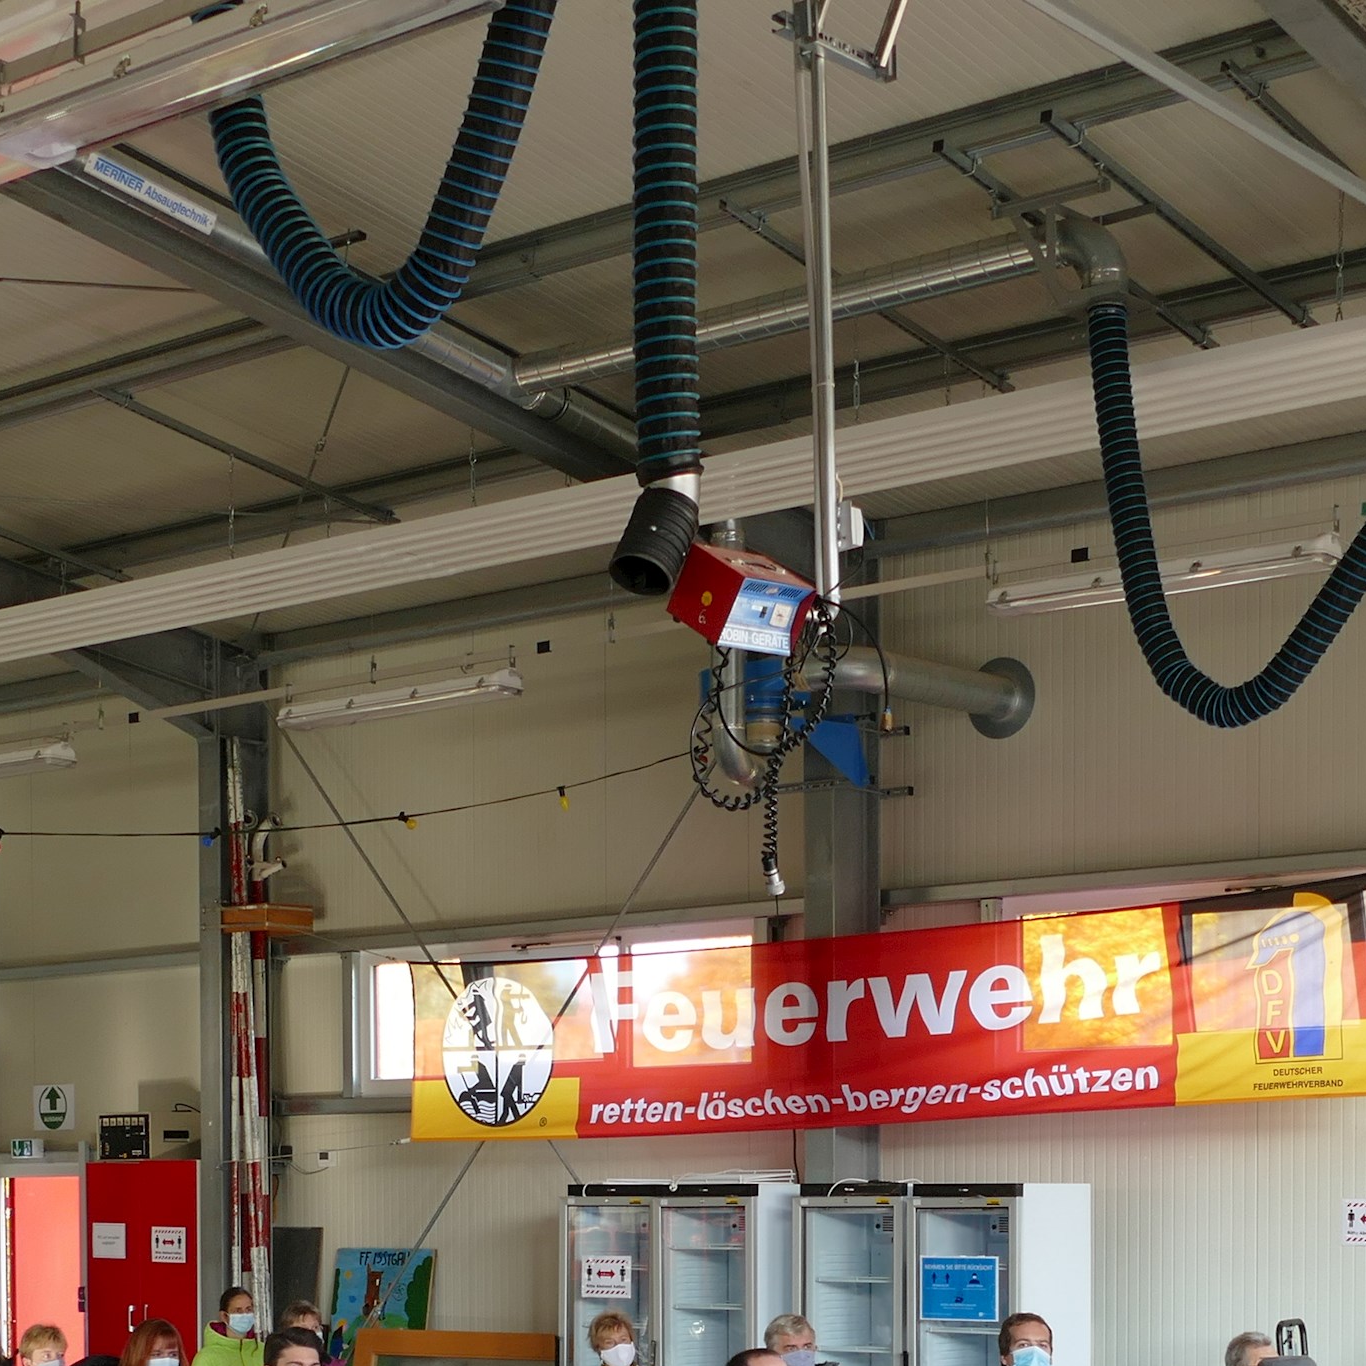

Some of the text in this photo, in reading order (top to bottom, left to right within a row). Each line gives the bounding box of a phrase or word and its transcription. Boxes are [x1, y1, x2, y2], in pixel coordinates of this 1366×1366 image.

[93, 158, 210, 227] MERTNER Absaugtechnik
[751, 632, 789, 649] GERÄTE
[591, 933, 1162, 1054] Feuerwehr
[1273, 1066, 1323, 1077] DEUTSCHER
[1253, 1079, 1344, 1091] FEUERWEHRVERBAND
[359, 1251, 372, 1266] FF
